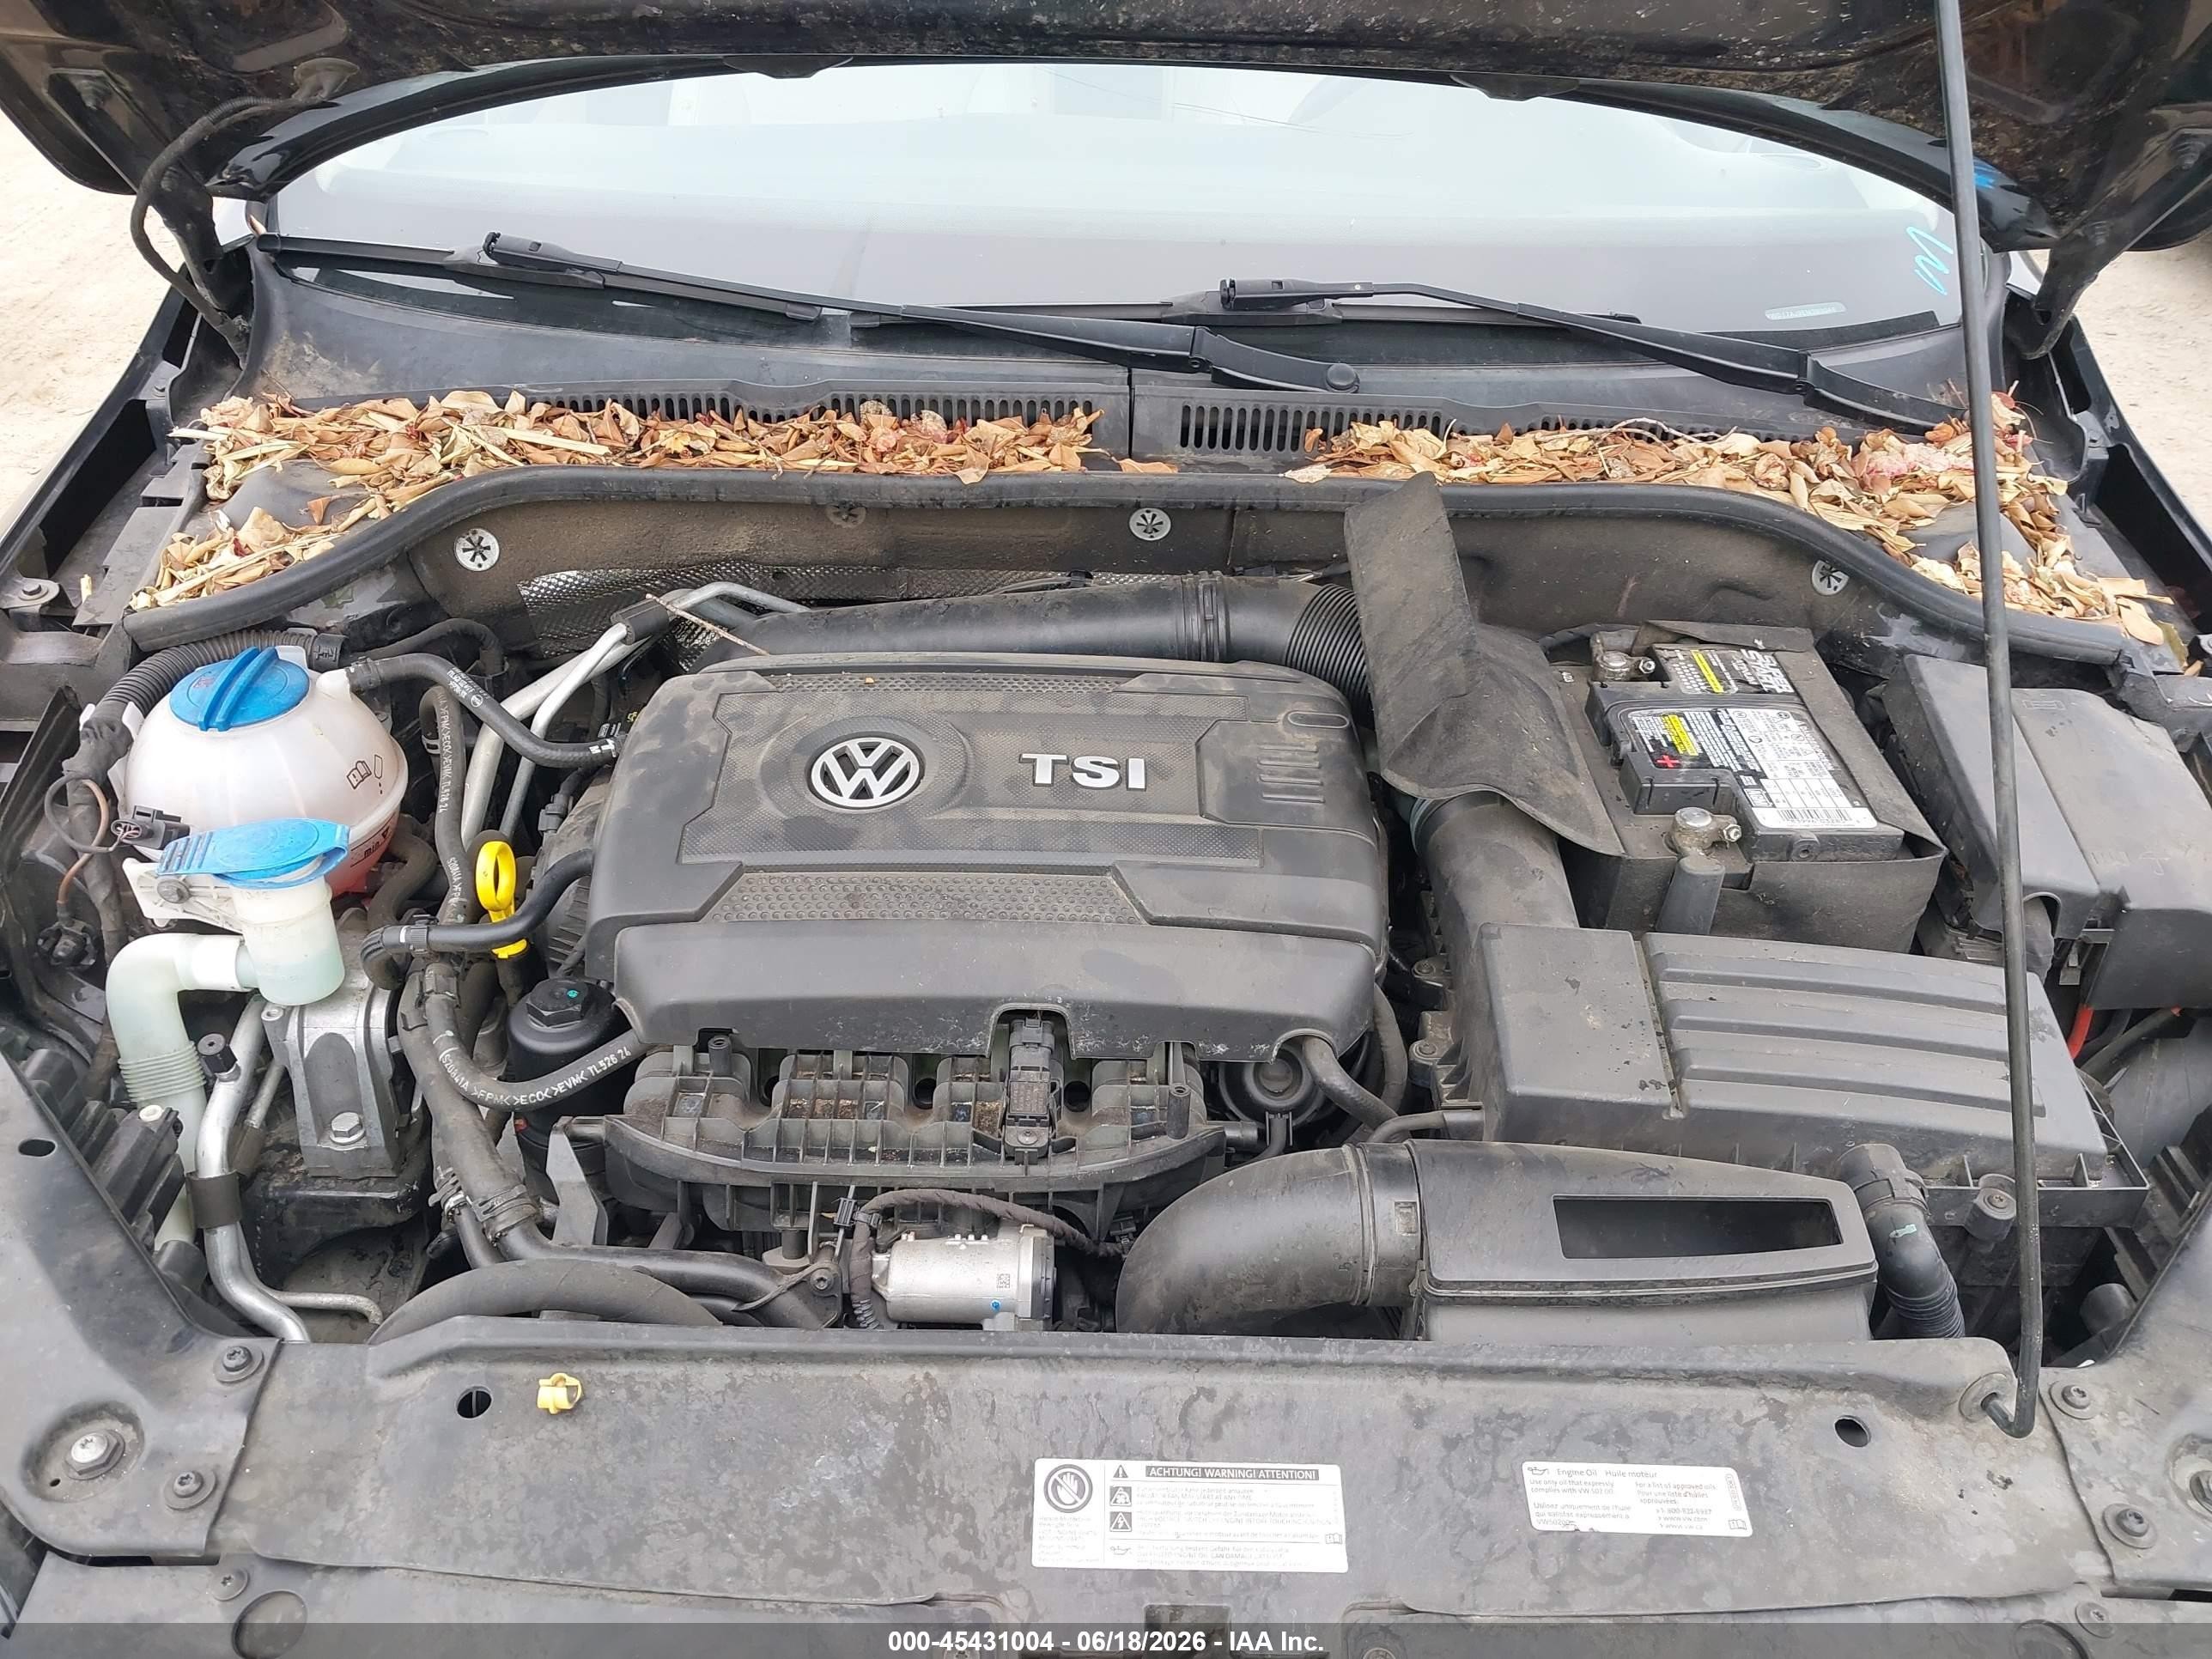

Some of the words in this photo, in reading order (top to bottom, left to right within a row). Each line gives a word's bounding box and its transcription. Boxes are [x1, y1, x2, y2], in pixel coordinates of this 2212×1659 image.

[1741, 649, 1771, 692] START
[1760, 654, 1795, 693] SUPER
[811, 736, 921, 809] VW
[1019, 753, 1147, 790] TSI
[364, 842, 380, 859] min
[589, 1054, 618, 1076] TL526
[619, 1046, 632, 1060] 24
[1149, 1467, 1201, 1478] ACHTUNG!
[1204, 1469, 1256, 1479] WARNING!
[1258, 1470, 1316, 1480] ATTENTION!
[1557, 1468, 1583, 1478] Engine
